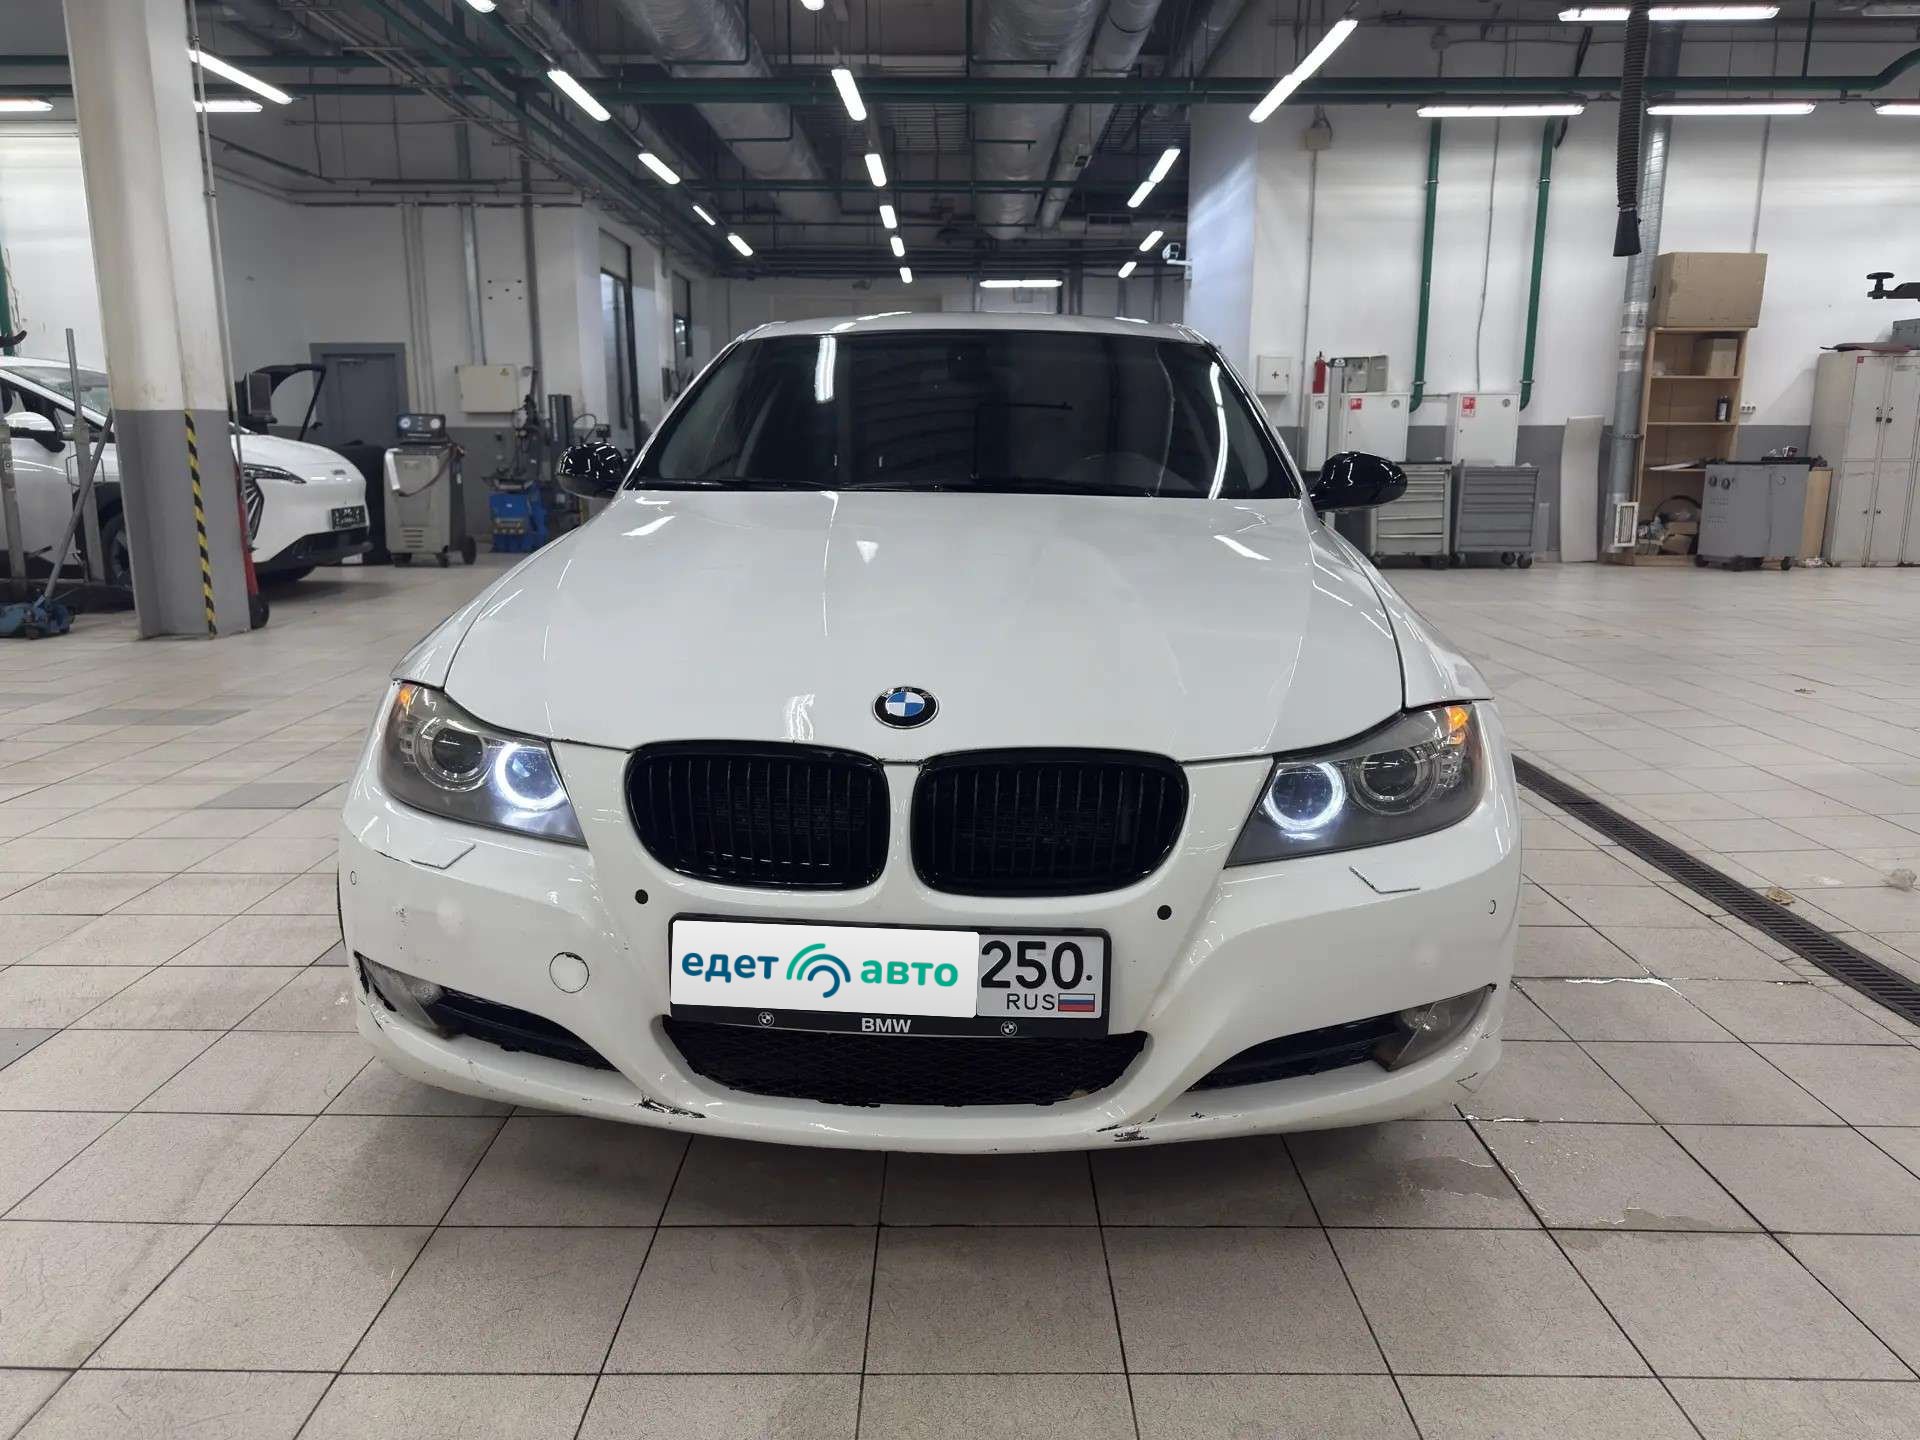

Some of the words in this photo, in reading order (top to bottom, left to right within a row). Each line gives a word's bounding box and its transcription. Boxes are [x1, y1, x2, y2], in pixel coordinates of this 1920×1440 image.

[981, 940, 1083, 990] 250
[1006, 993, 1055, 1010] RUS
[861, 1017, 912, 1033] BMW
